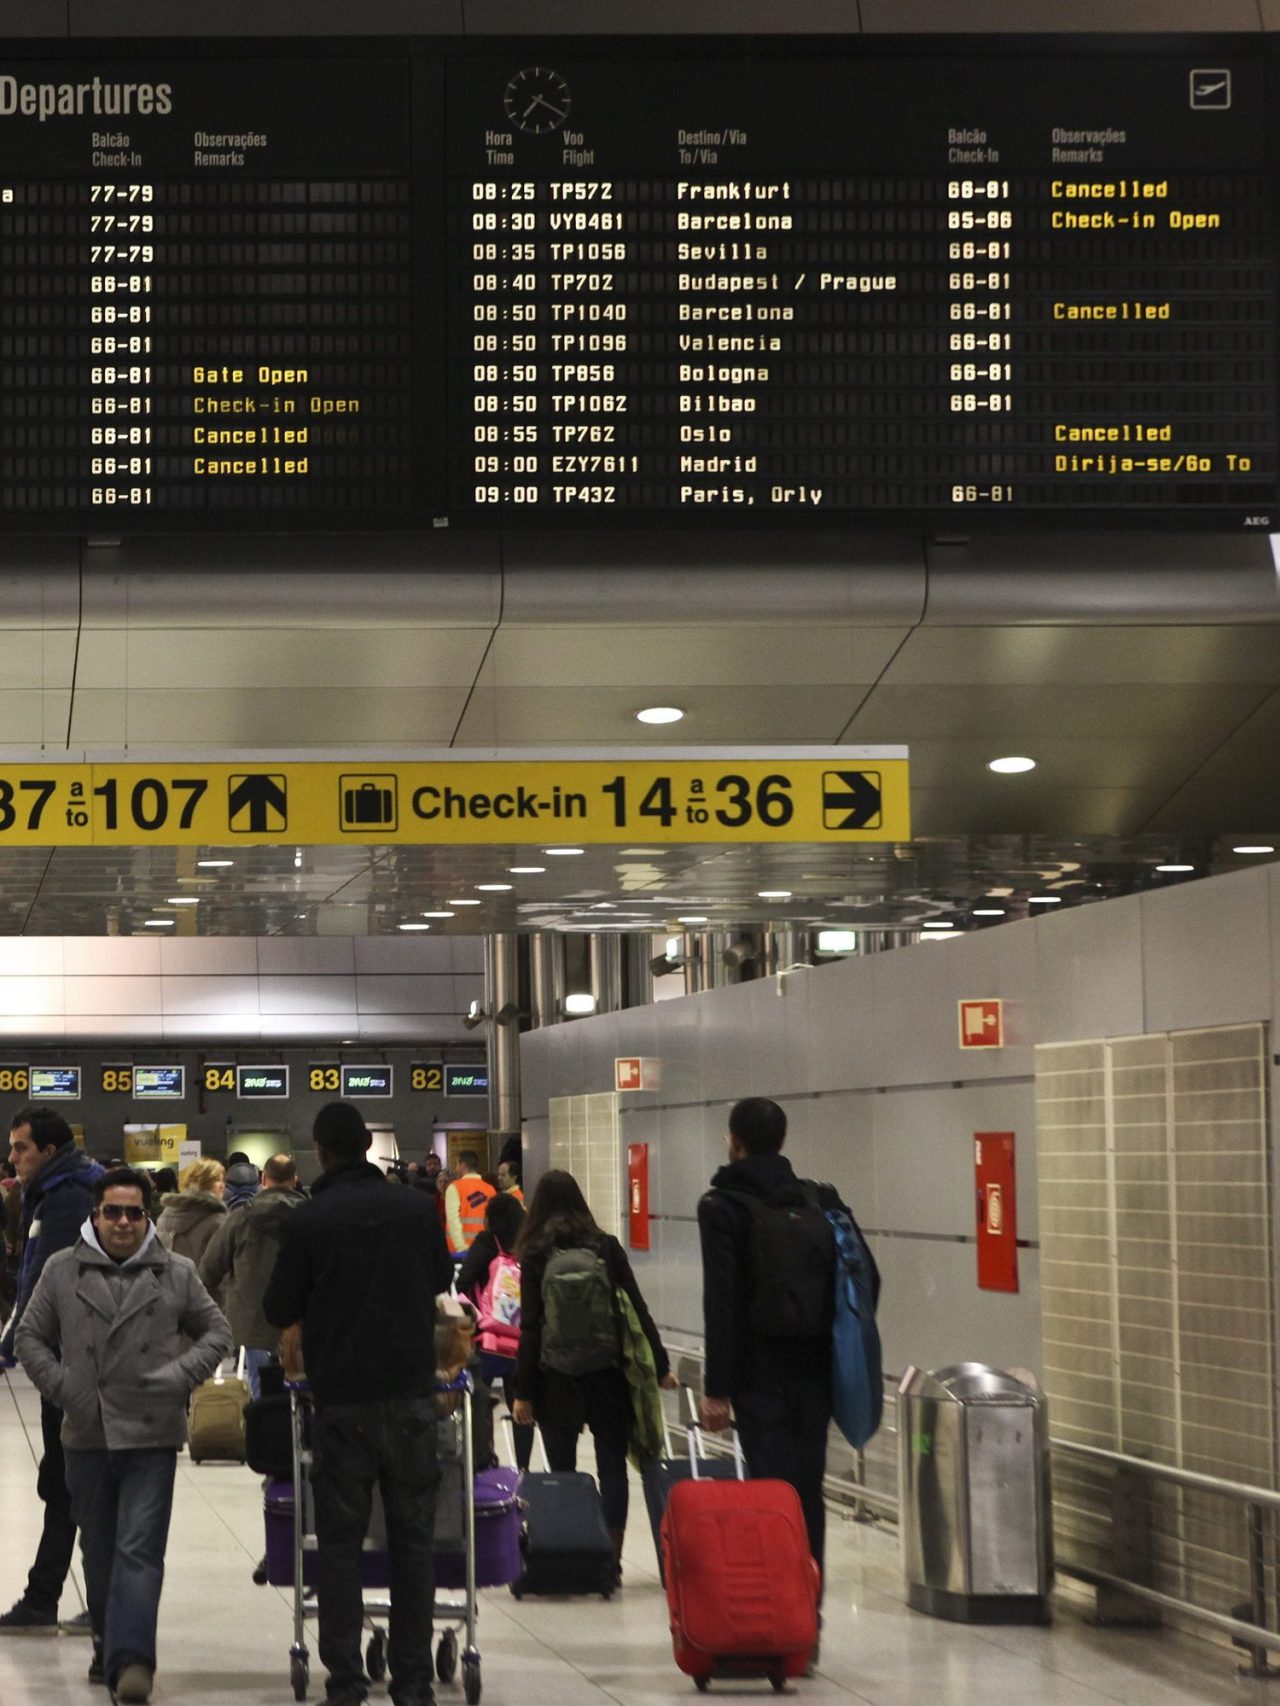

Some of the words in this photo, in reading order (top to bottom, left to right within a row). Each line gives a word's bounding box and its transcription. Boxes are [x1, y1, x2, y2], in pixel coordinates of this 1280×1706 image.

[92, 132, 130, 148] Balcão
[194, 131, 267, 151] Observações
[194, 151, 244, 166] Remarks
[550, 182, 612, 200] TP572
[677, 182, 790, 200] Frankfurt
[1051, 180, 1168, 198] Cancelled
[550, 212, 623, 230] VY8461
[677, 212, 793, 230] Barcelona
[1051, 211, 1155, 229] Check-in
[1169, 210, 1220, 230] Open
[550, 243, 626, 261] TP1056
[678, 243, 767, 260] Sevilla
[551, 273, 613, 291] TP702
[678, 273, 778, 293] Budapest
[820, 273, 897, 293] Prague
[551, 304, 626, 321] TP1040
[679, 303, 794, 321] Barcelona
[1053, 302, 1170, 320] Cancelled
[551, 334, 627, 352] TP1096
[679, 334, 781, 351] Valencia
[193, 366, 244, 384] Gate
[258, 366, 308, 385] Open
[551, 364, 615, 382] TP856
[679, 364, 769, 384] Bologna
[193, 396, 296, 414] Check-in
[310, 396, 359, 415] Open
[551, 395, 627, 412] TP1062
[679, 395, 756, 412] Bilbao
[193, 427, 308, 444] Cancelled
[552, 425, 615, 443] TP762
[680, 425, 731, 443] Oslo
[1055, 424, 1172, 442] Cancelled
[194, 457, 308, 474] Cancelled
[552, 455, 638, 473] EZY7611
[680, 455, 757, 473] Madrid
[1226, 454, 1251, 471] To
[552, 486, 616, 503] TP432
[771, 486, 822, 505] Orly
[1244, 516, 1270, 526] AEG
[70, 781, 84, 797] a
[690, 779, 703, 794] a
[93, 778, 209, 830] 107
[412, 786, 587, 820] Check-in
[601, 776, 678, 828] 14
[715, 775, 794, 828] 36
[66, 808, 88, 827] to
[686, 806, 709, 824] to
[102, 1070, 132, 1091] 85
[205, 1069, 235, 1090] 84
[310, 1069, 340, 1090] 83
[412, 1069, 441, 1090] 82
[134, 1135, 174, 1149] vueling
